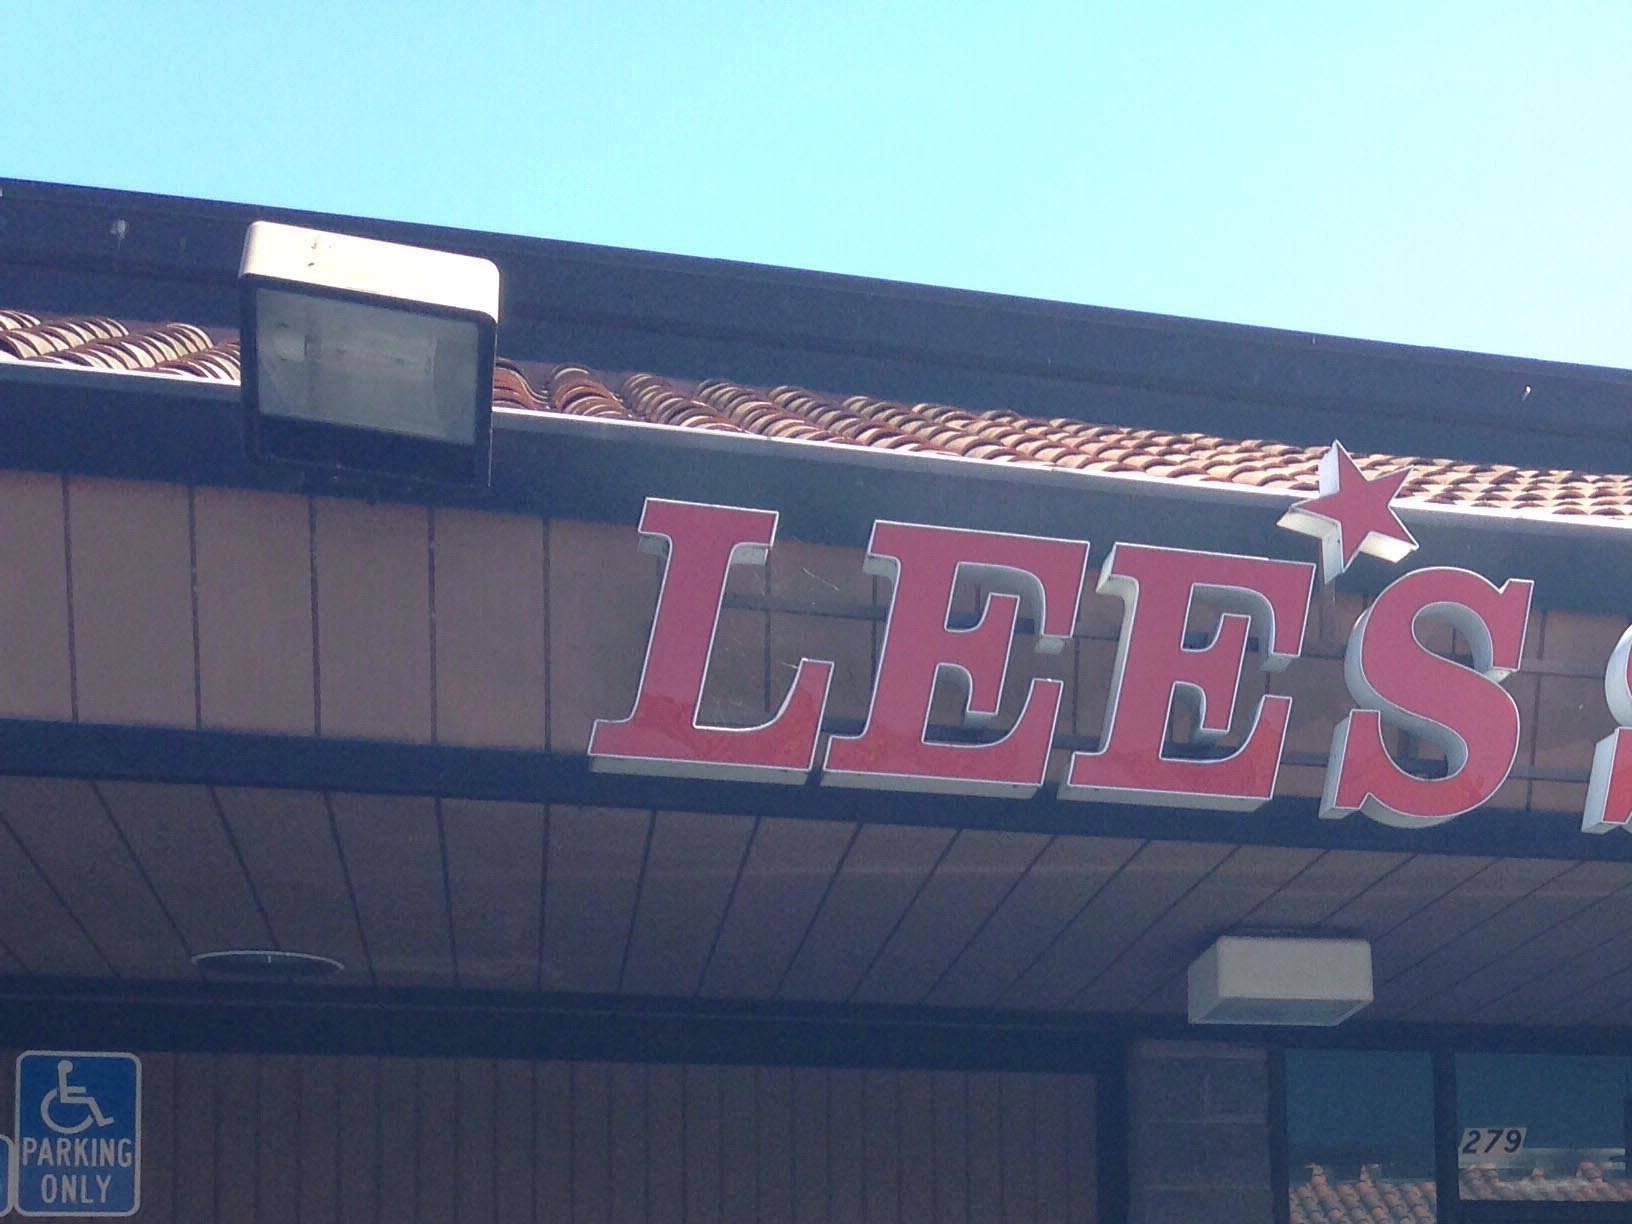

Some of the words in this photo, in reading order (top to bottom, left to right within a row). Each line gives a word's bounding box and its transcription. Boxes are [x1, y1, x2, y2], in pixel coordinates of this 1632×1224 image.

[584, 440, 1534, 826] LEE'S
[22, 1137, 132, 1168] PARKING
[1461, 1128, 1524, 1154] 279
[41, 1173, 112, 1204] ONLY
